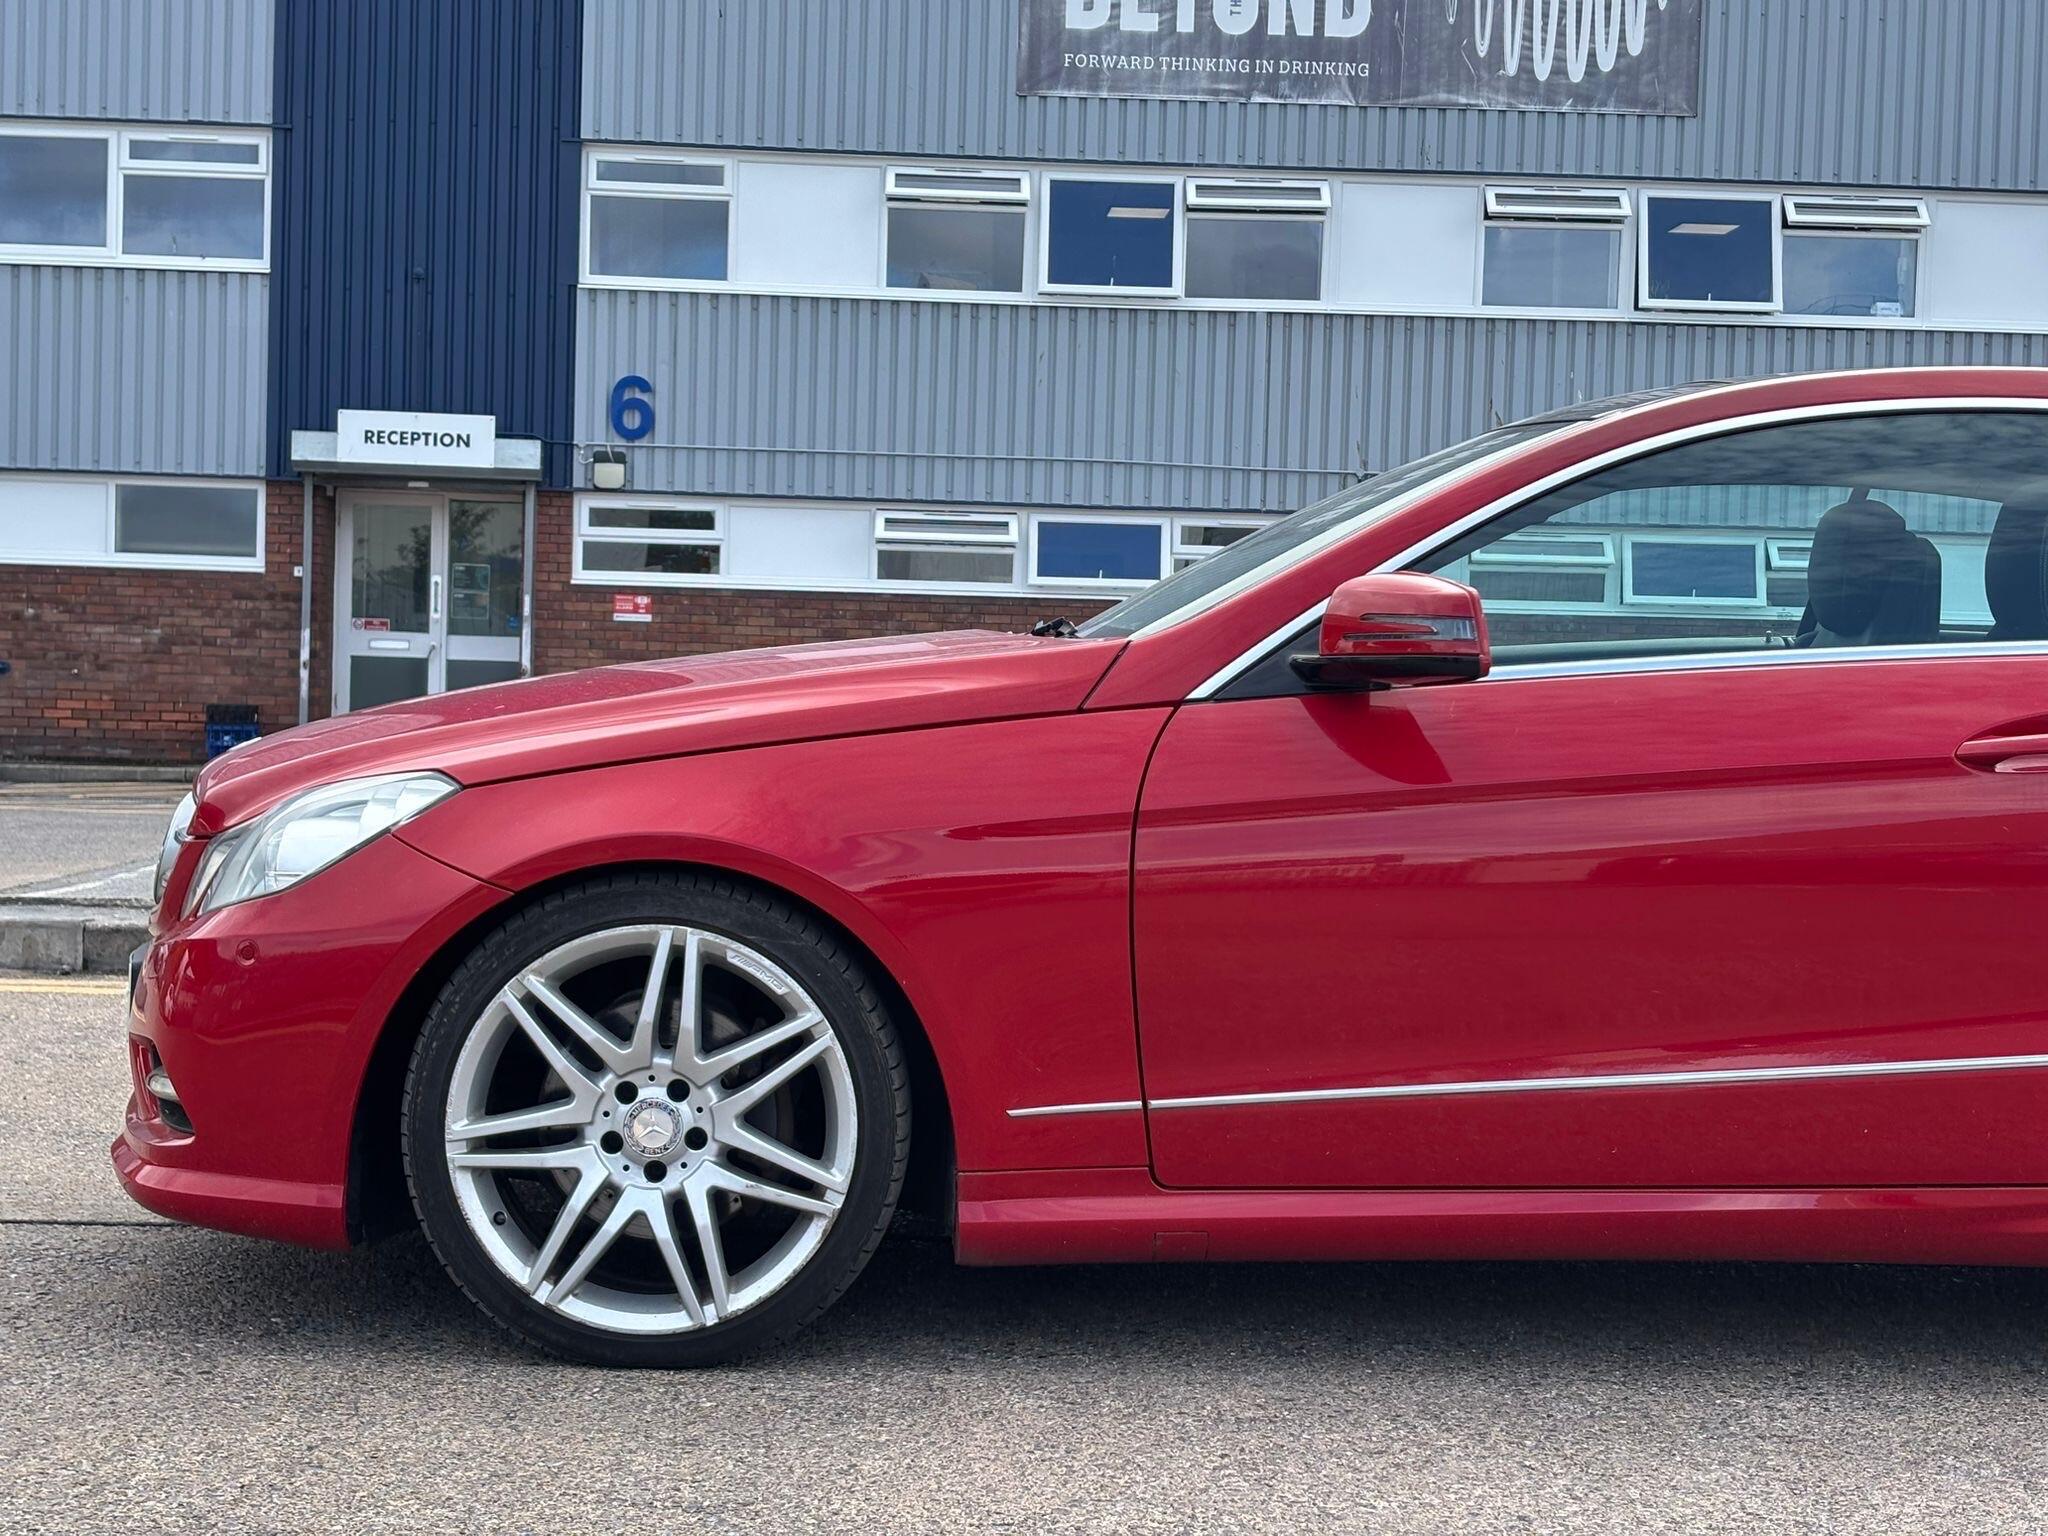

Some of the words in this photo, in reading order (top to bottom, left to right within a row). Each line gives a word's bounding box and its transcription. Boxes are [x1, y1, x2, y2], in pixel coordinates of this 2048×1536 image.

[1064, 53, 1155, 71] FORWARD
[1159, 56, 1250, 73] THINKING
[1255, 59, 1274, 74] IN
[1279, 60, 1370, 77] DRINKING
[611, 375, 655, 441] 6
[363, 429, 471, 448] RECEPTION
[632, 1101, 672, 1117] MERCEDES
[644, 1146, 666, 1155] BENZ
